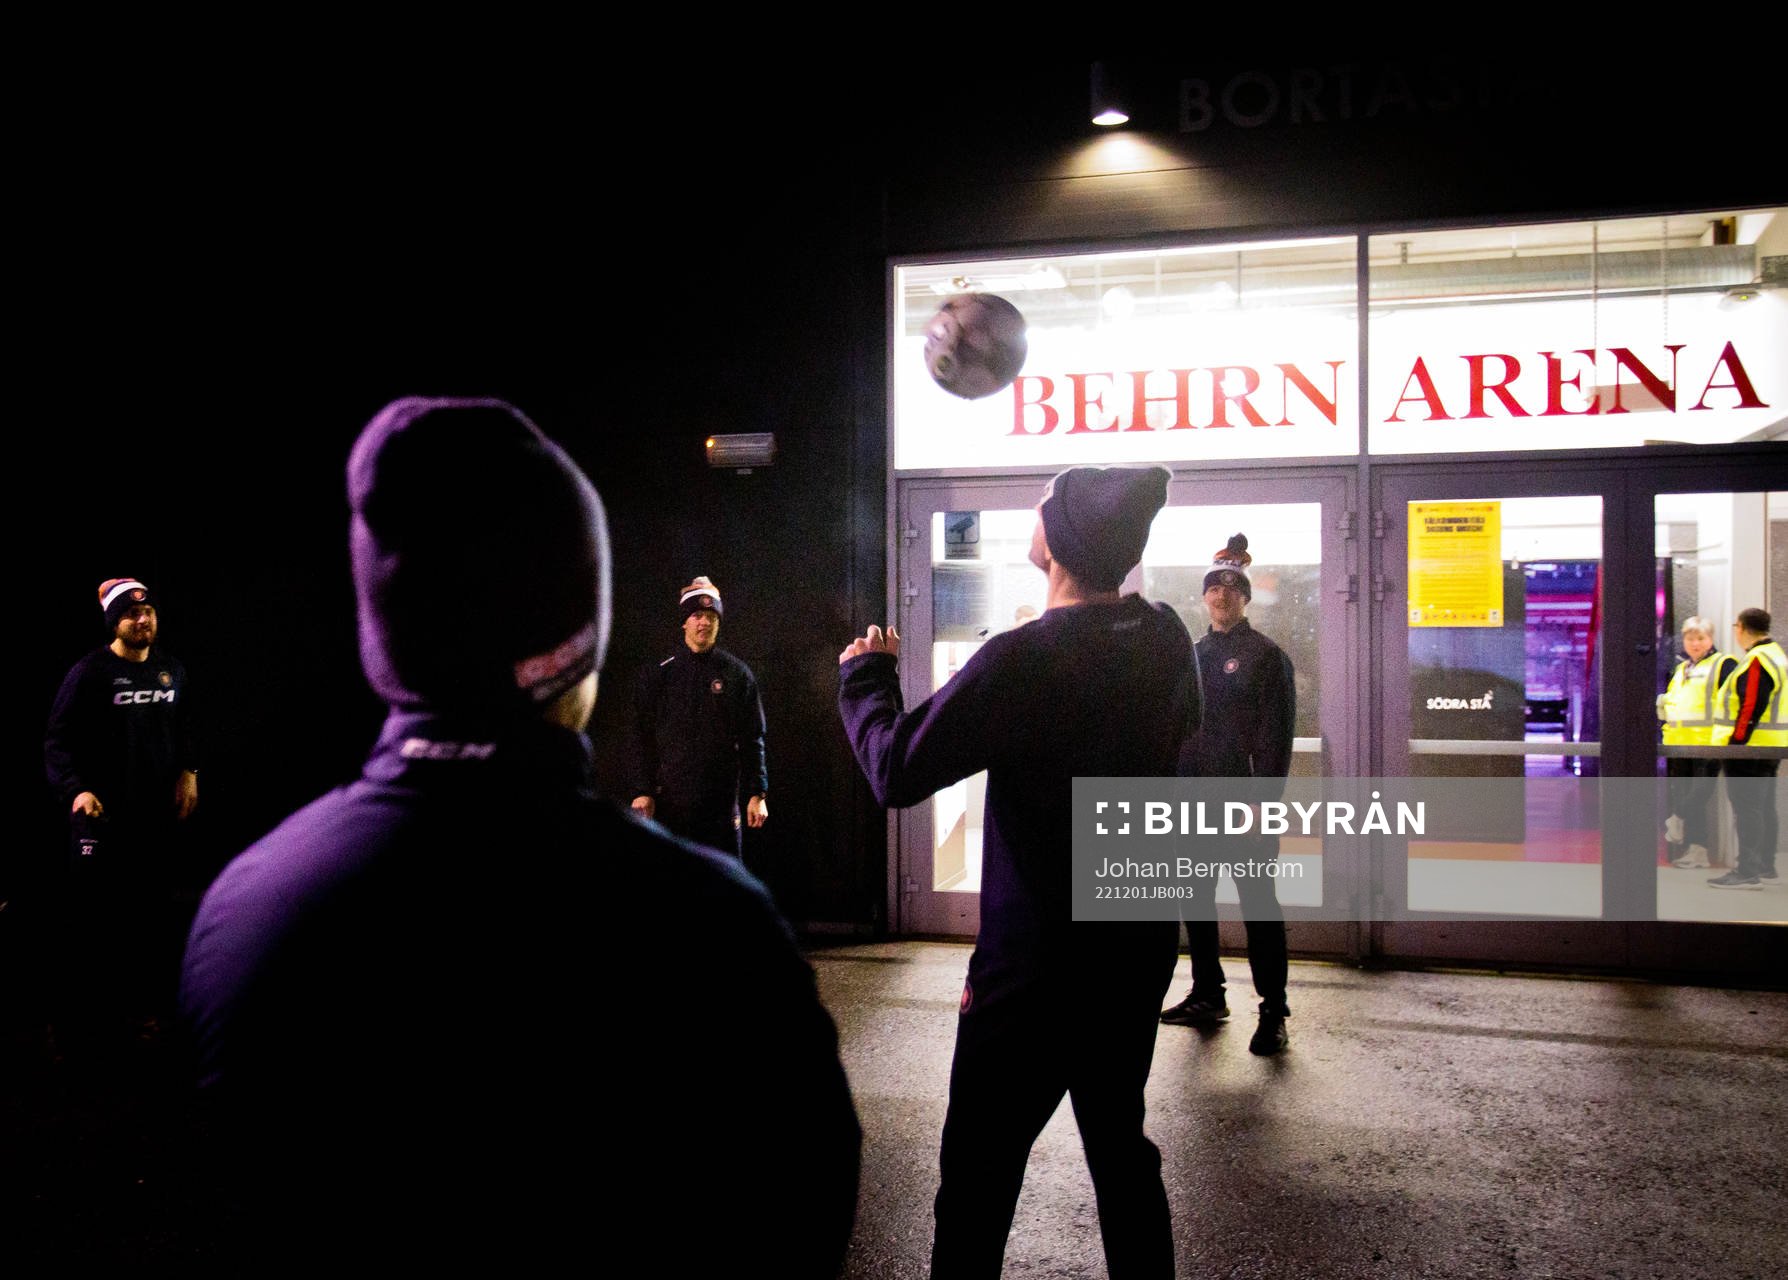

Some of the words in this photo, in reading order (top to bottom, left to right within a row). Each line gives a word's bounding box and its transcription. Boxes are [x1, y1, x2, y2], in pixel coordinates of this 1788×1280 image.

[1008, 360, 1345, 435] BEHRN
[1384, 339, 1770, 424] ARENA
[113, 689, 175, 705] CCM
[1426, 696, 1469, 710] SÖDRA
